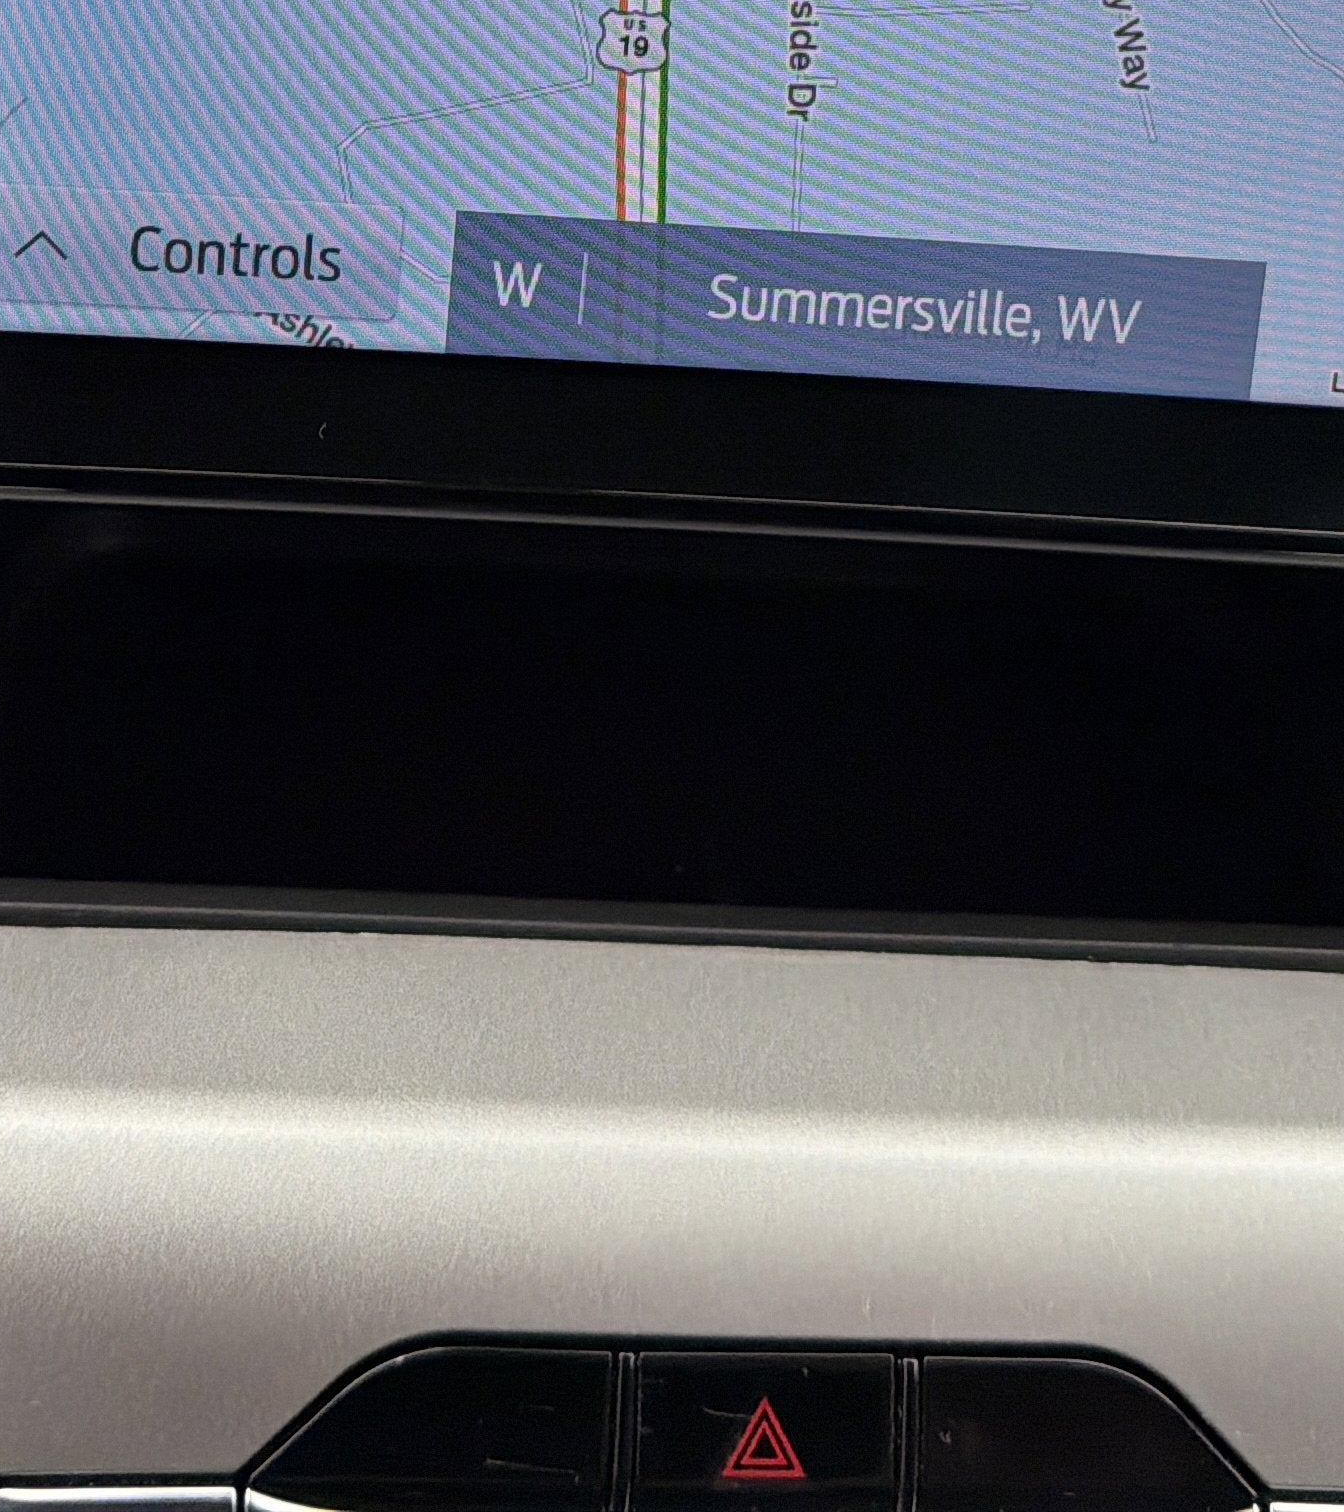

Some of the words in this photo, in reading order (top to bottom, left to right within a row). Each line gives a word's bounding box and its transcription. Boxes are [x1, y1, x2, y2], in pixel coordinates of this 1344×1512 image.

[619, 34, 649, 57] 19
[623, 18, 646, 32] US
[1113, 18, 1150, 91] Way
[786, 84, 817, 122] Dr
[130, 225, 342, 283] Controls
[492, 260, 543, 308] W
[707, 274, 1041, 345] Summersville,
[1057, 295, 1142, 344] WV
